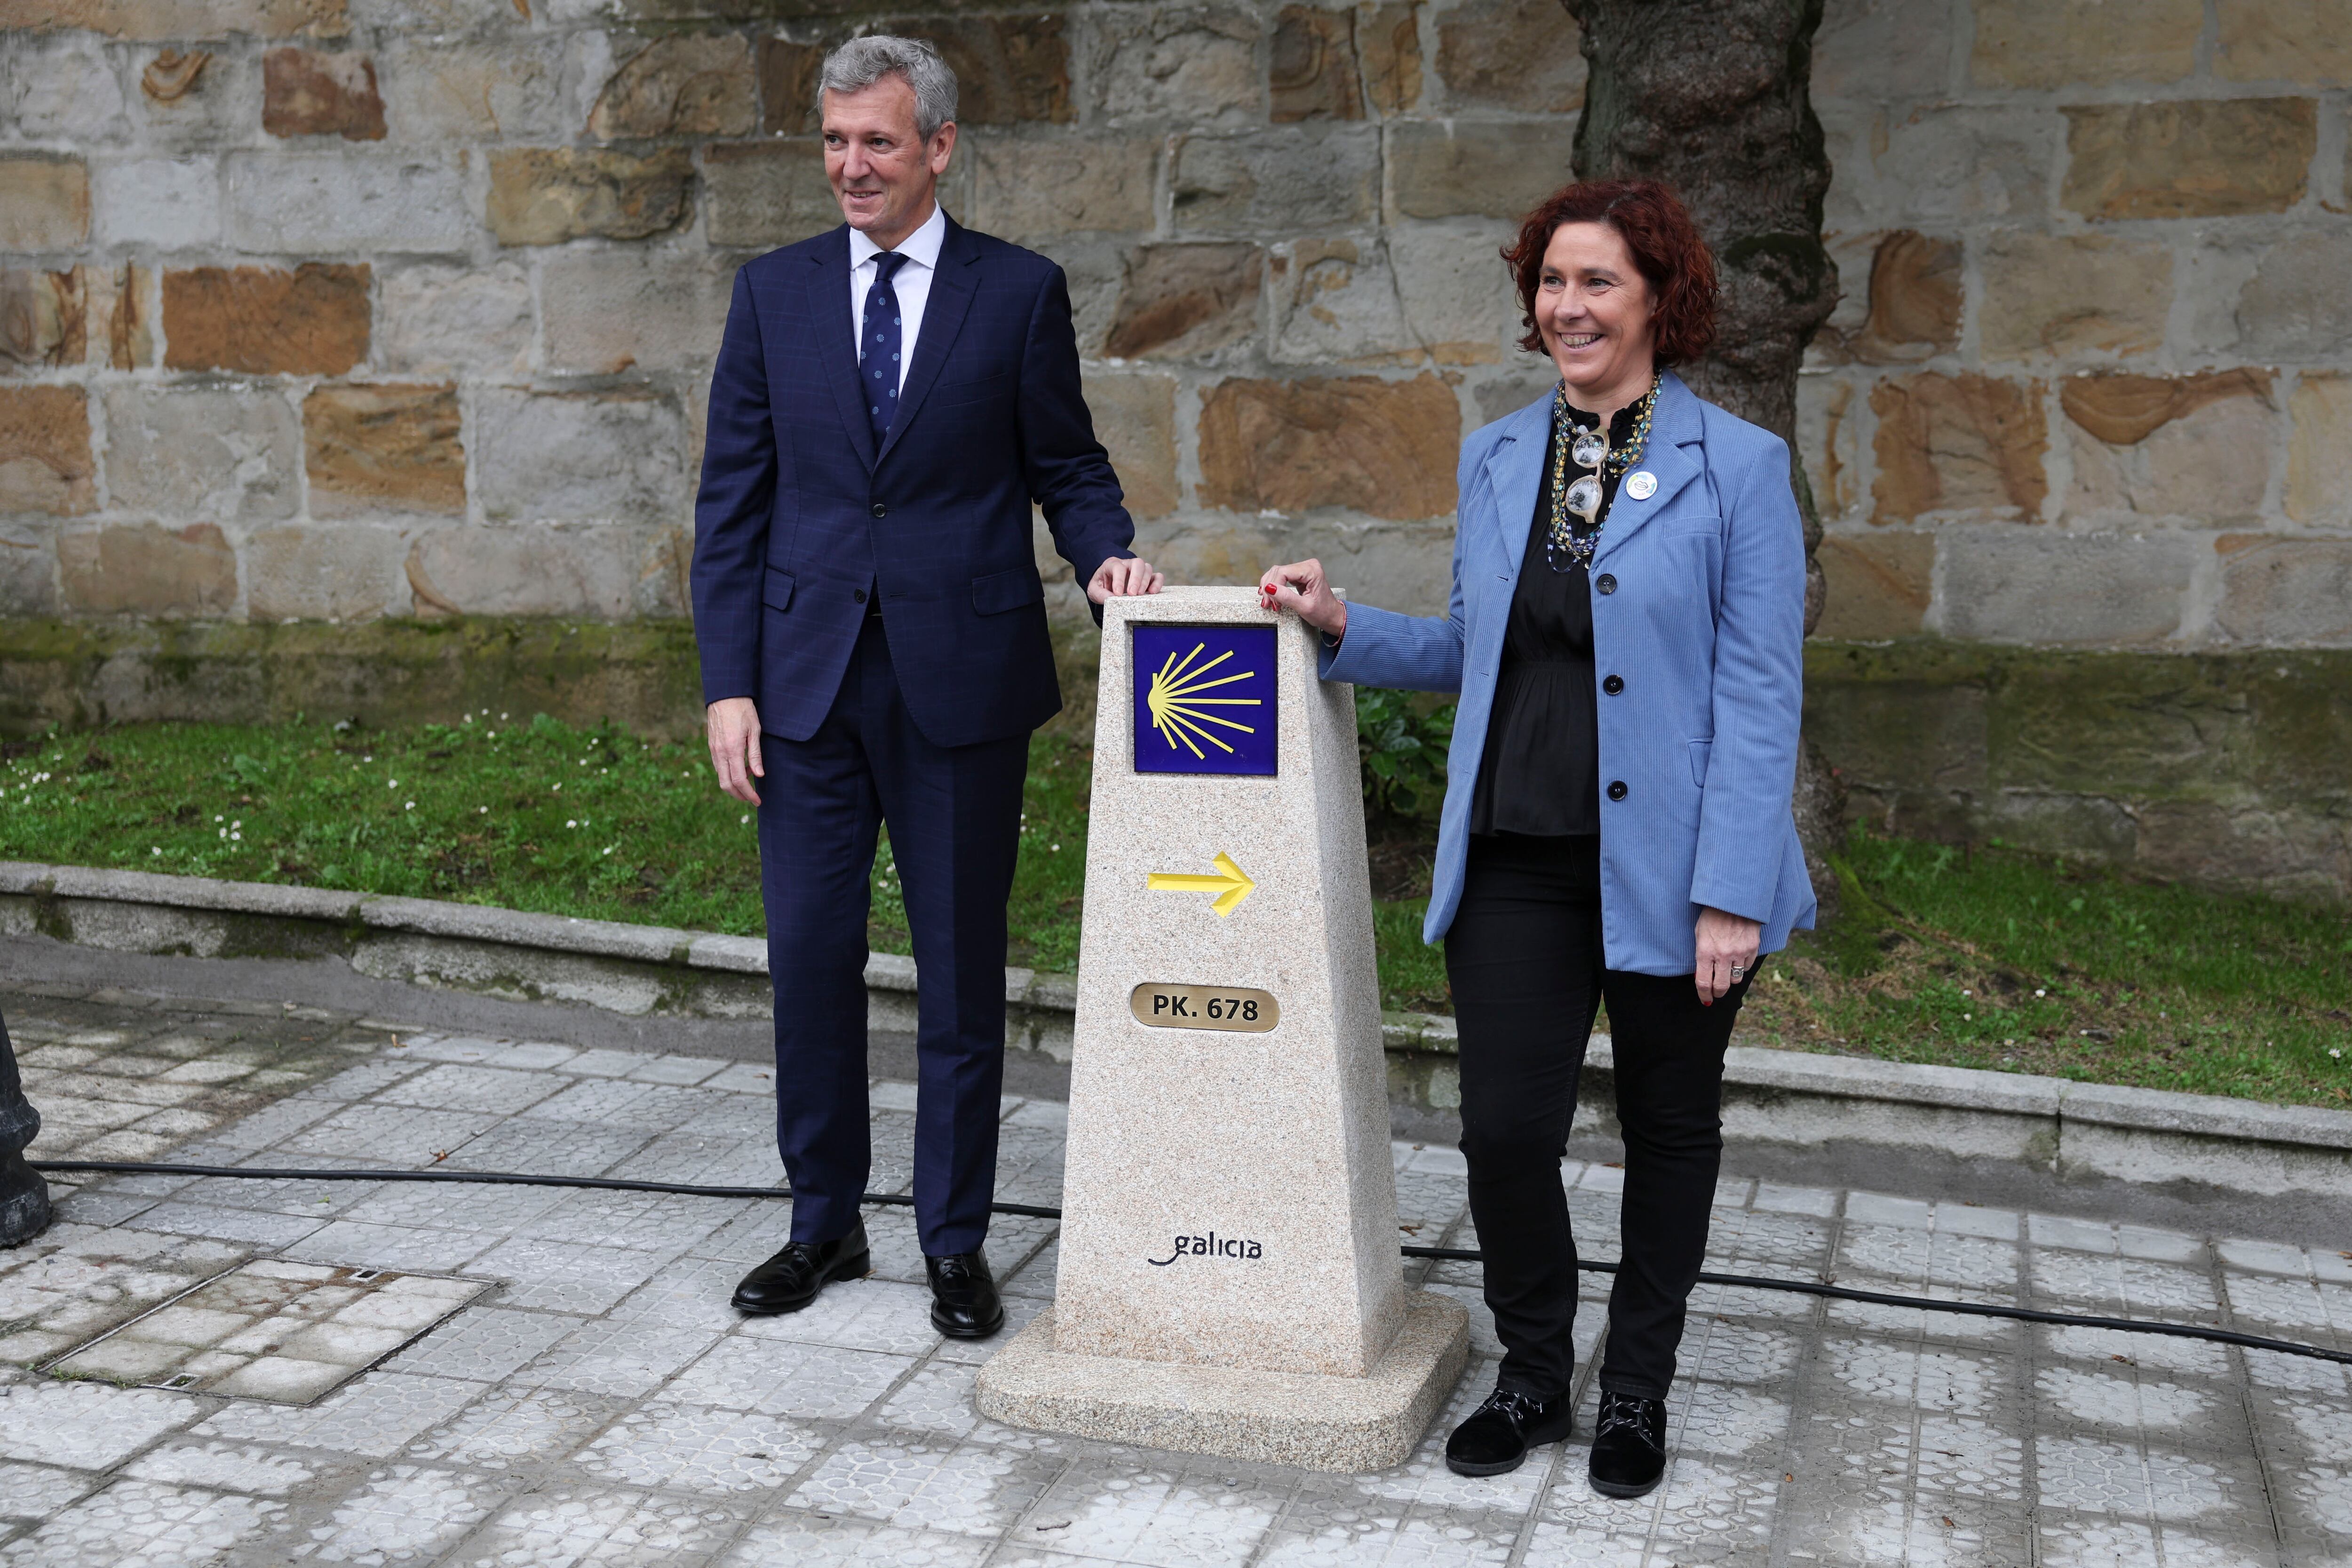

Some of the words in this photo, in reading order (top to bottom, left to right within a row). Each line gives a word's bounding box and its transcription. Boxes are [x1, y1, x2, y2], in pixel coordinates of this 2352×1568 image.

[1154, 994, 1197, 1017] PK.
[1207, 998, 1258, 1021] 678
[1148, 1231, 1262, 1266] galicia
